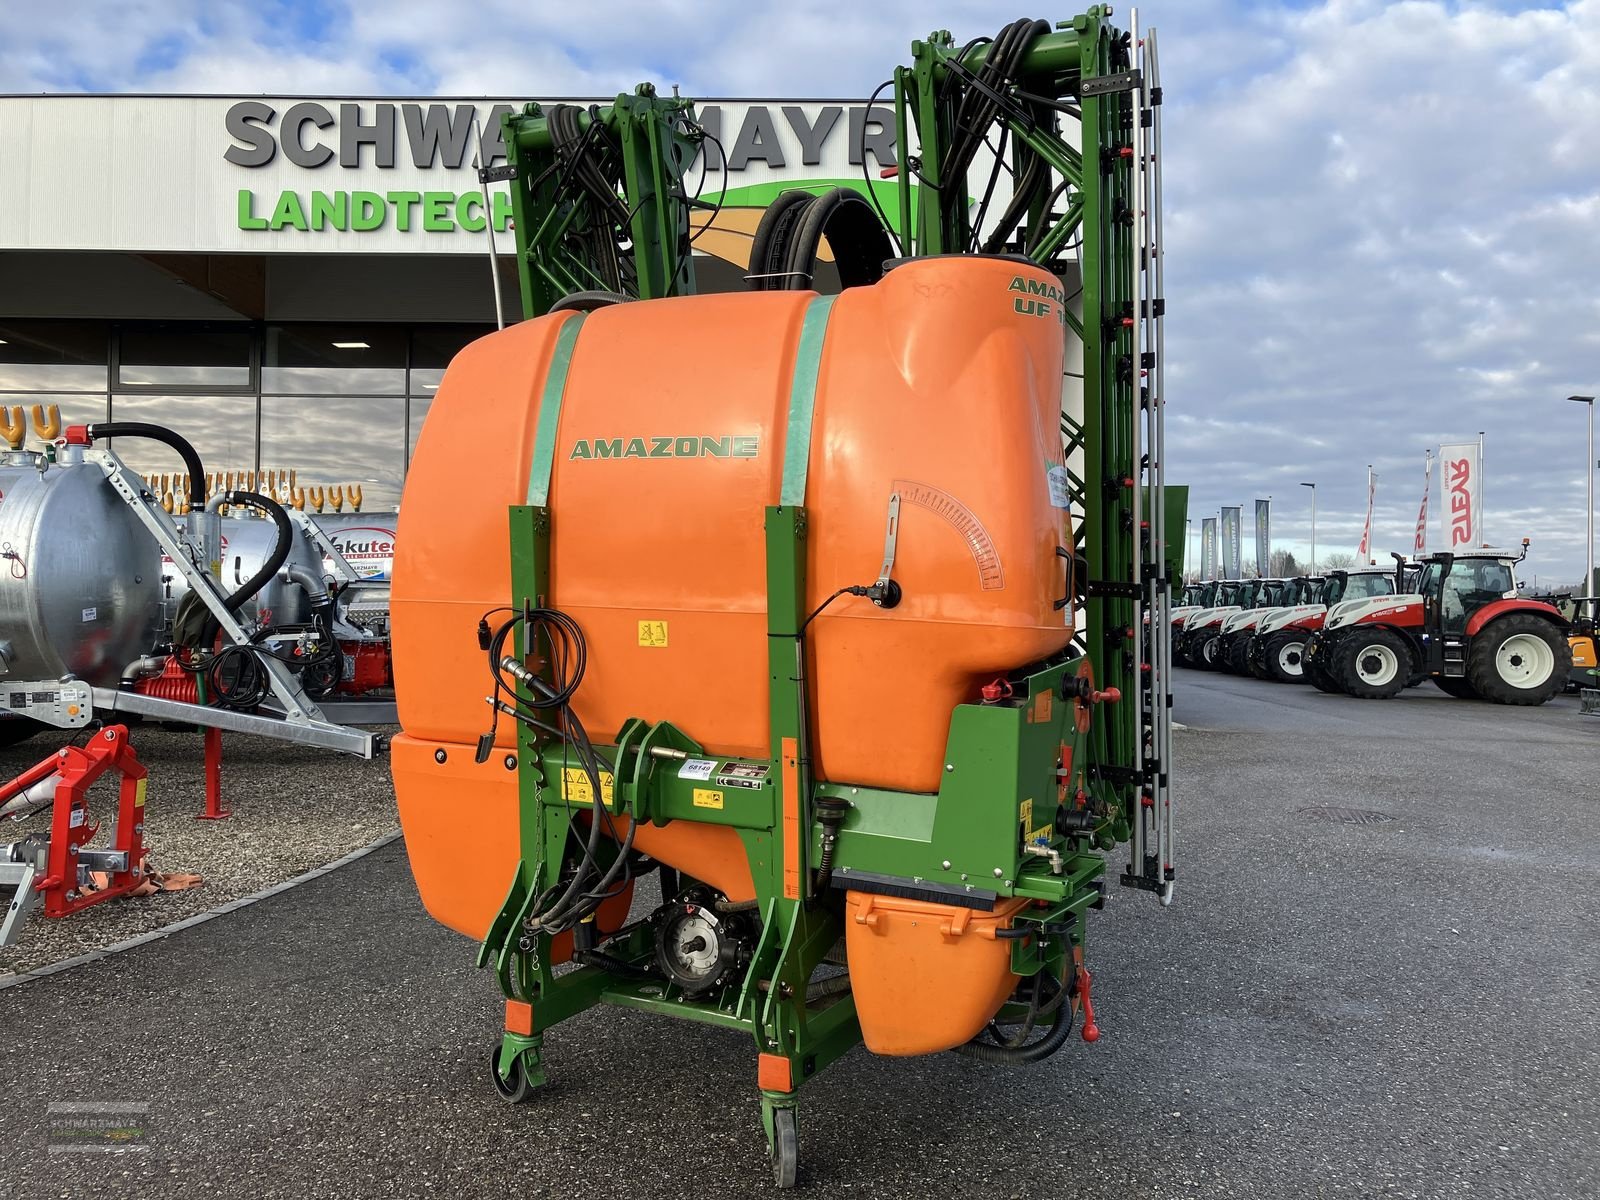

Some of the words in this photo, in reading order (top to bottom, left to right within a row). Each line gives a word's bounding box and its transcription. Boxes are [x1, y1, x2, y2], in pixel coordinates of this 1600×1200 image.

[1014, 298, 1050, 317] UF
[569, 436, 759, 460] AMAZONE
[688, 764, 711, 772] 68149
